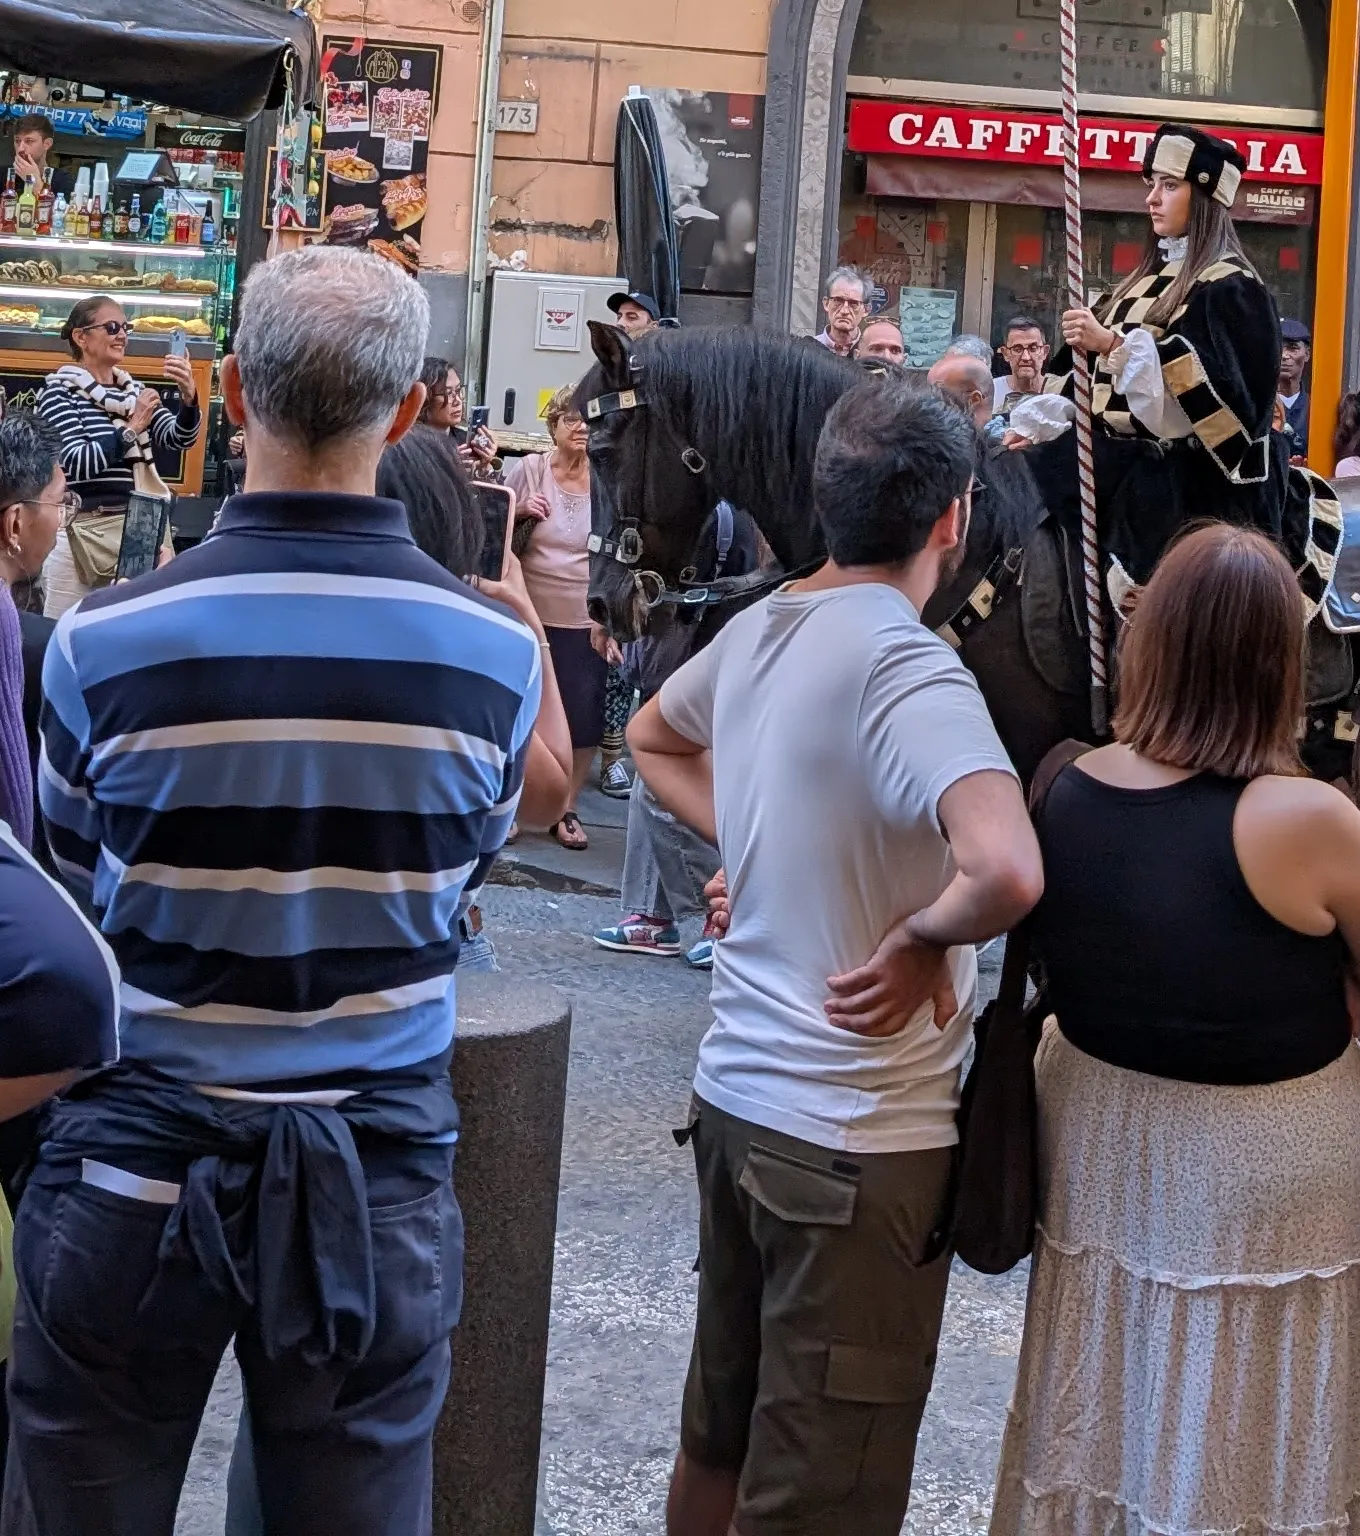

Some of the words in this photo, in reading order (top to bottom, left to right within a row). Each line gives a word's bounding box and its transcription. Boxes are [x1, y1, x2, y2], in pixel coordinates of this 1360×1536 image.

[1041, 32, 1141, 53] CFFEE
[67, 111, 87, 125] 77
[498, 107, 532, 124] 173
[888, 112, 1308, 176] CAFFETTIA
[1246, 193, 1306, 208] MAURO
